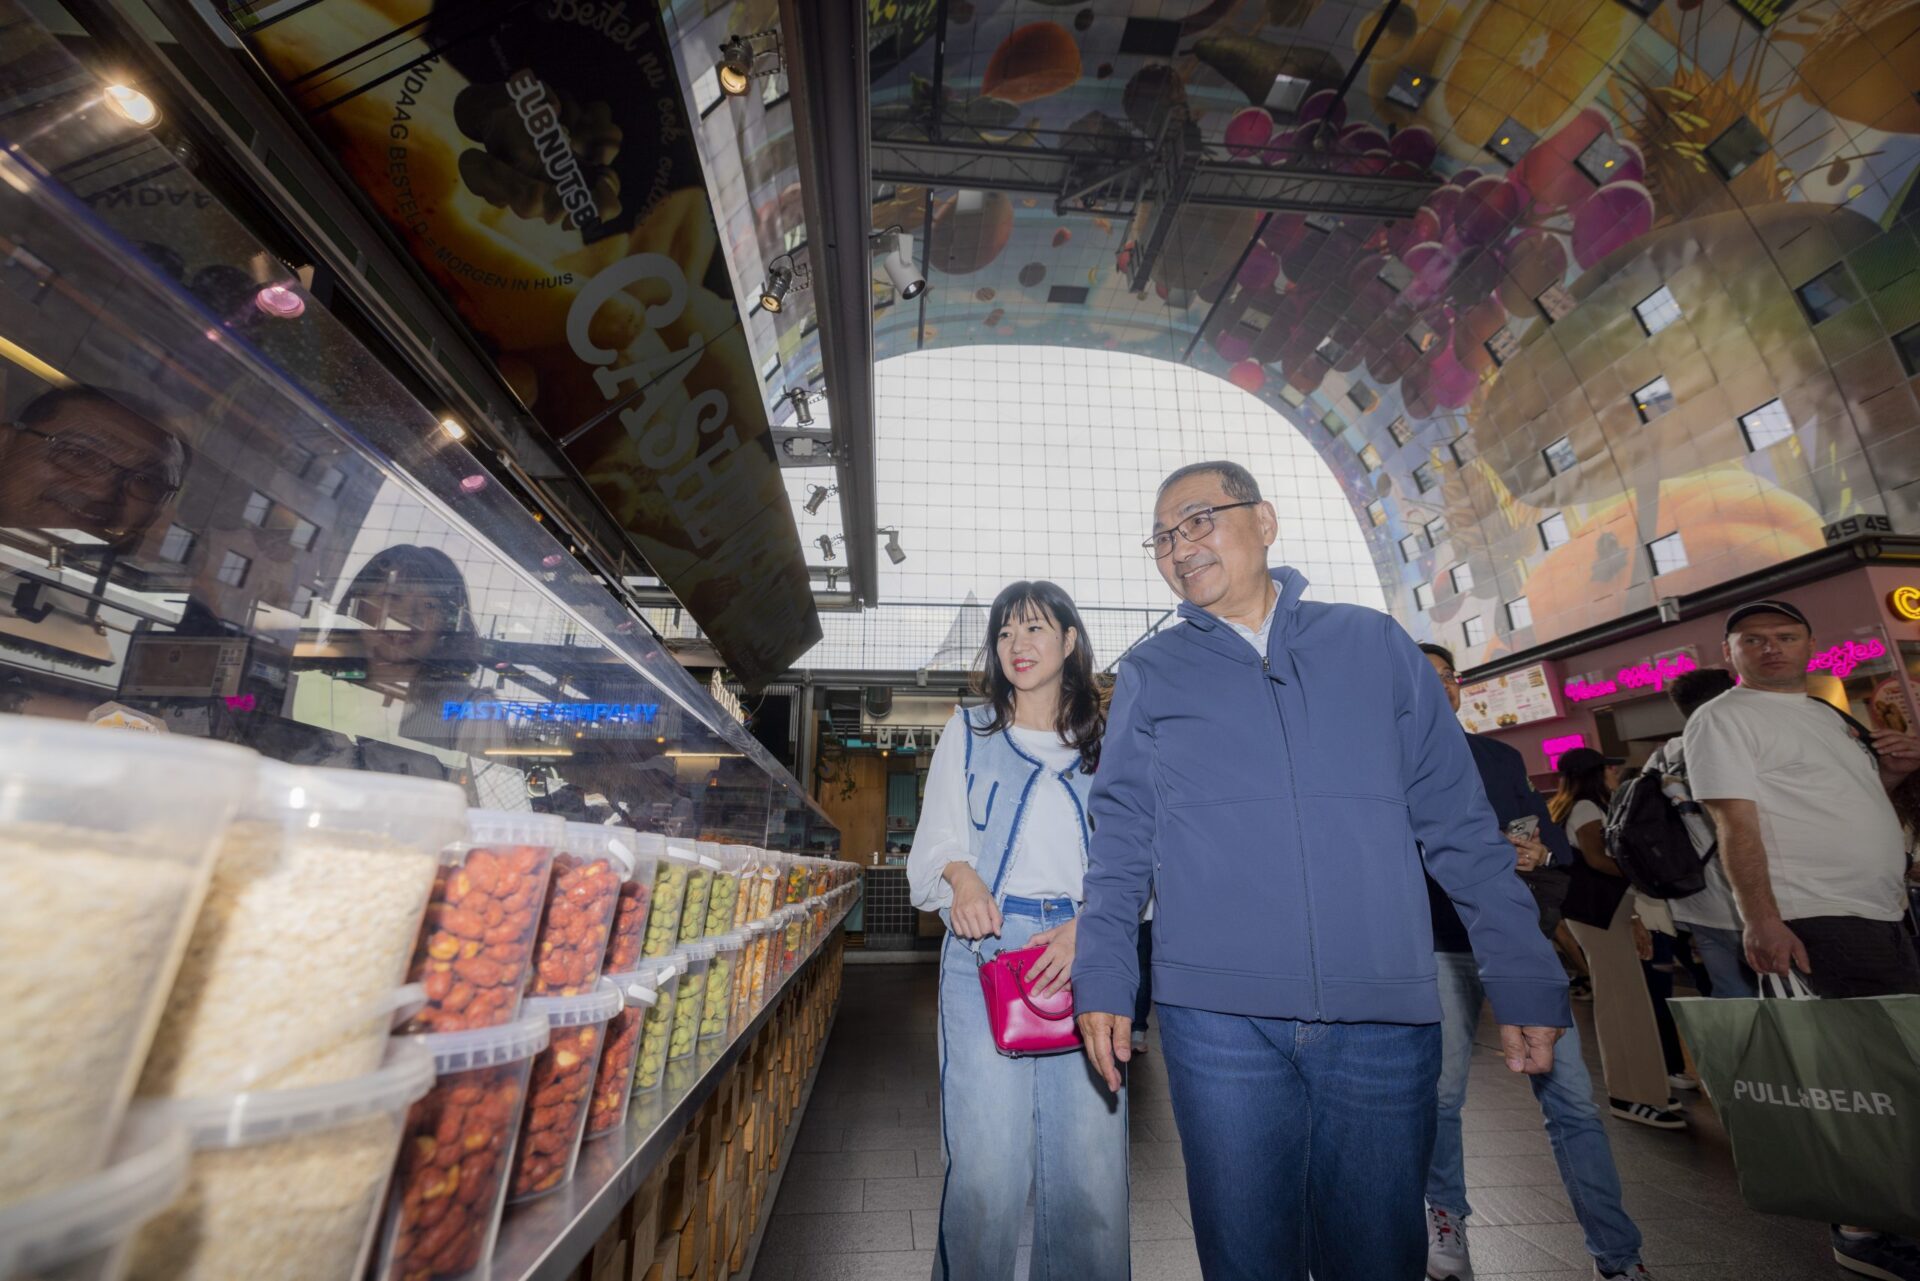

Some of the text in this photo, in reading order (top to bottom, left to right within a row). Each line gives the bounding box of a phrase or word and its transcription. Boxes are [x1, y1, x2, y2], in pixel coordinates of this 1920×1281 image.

[389, 149, 428, 236] BESTELD
[436, 243, 508, 289] MORGEN
[511, 277, 530, 291] IN
[534, 272, 574, 292] HUIS
[1827, 515, 1892, 540] 49 49
[1733, 1079, 1897, 1117] PULL&BEAR
